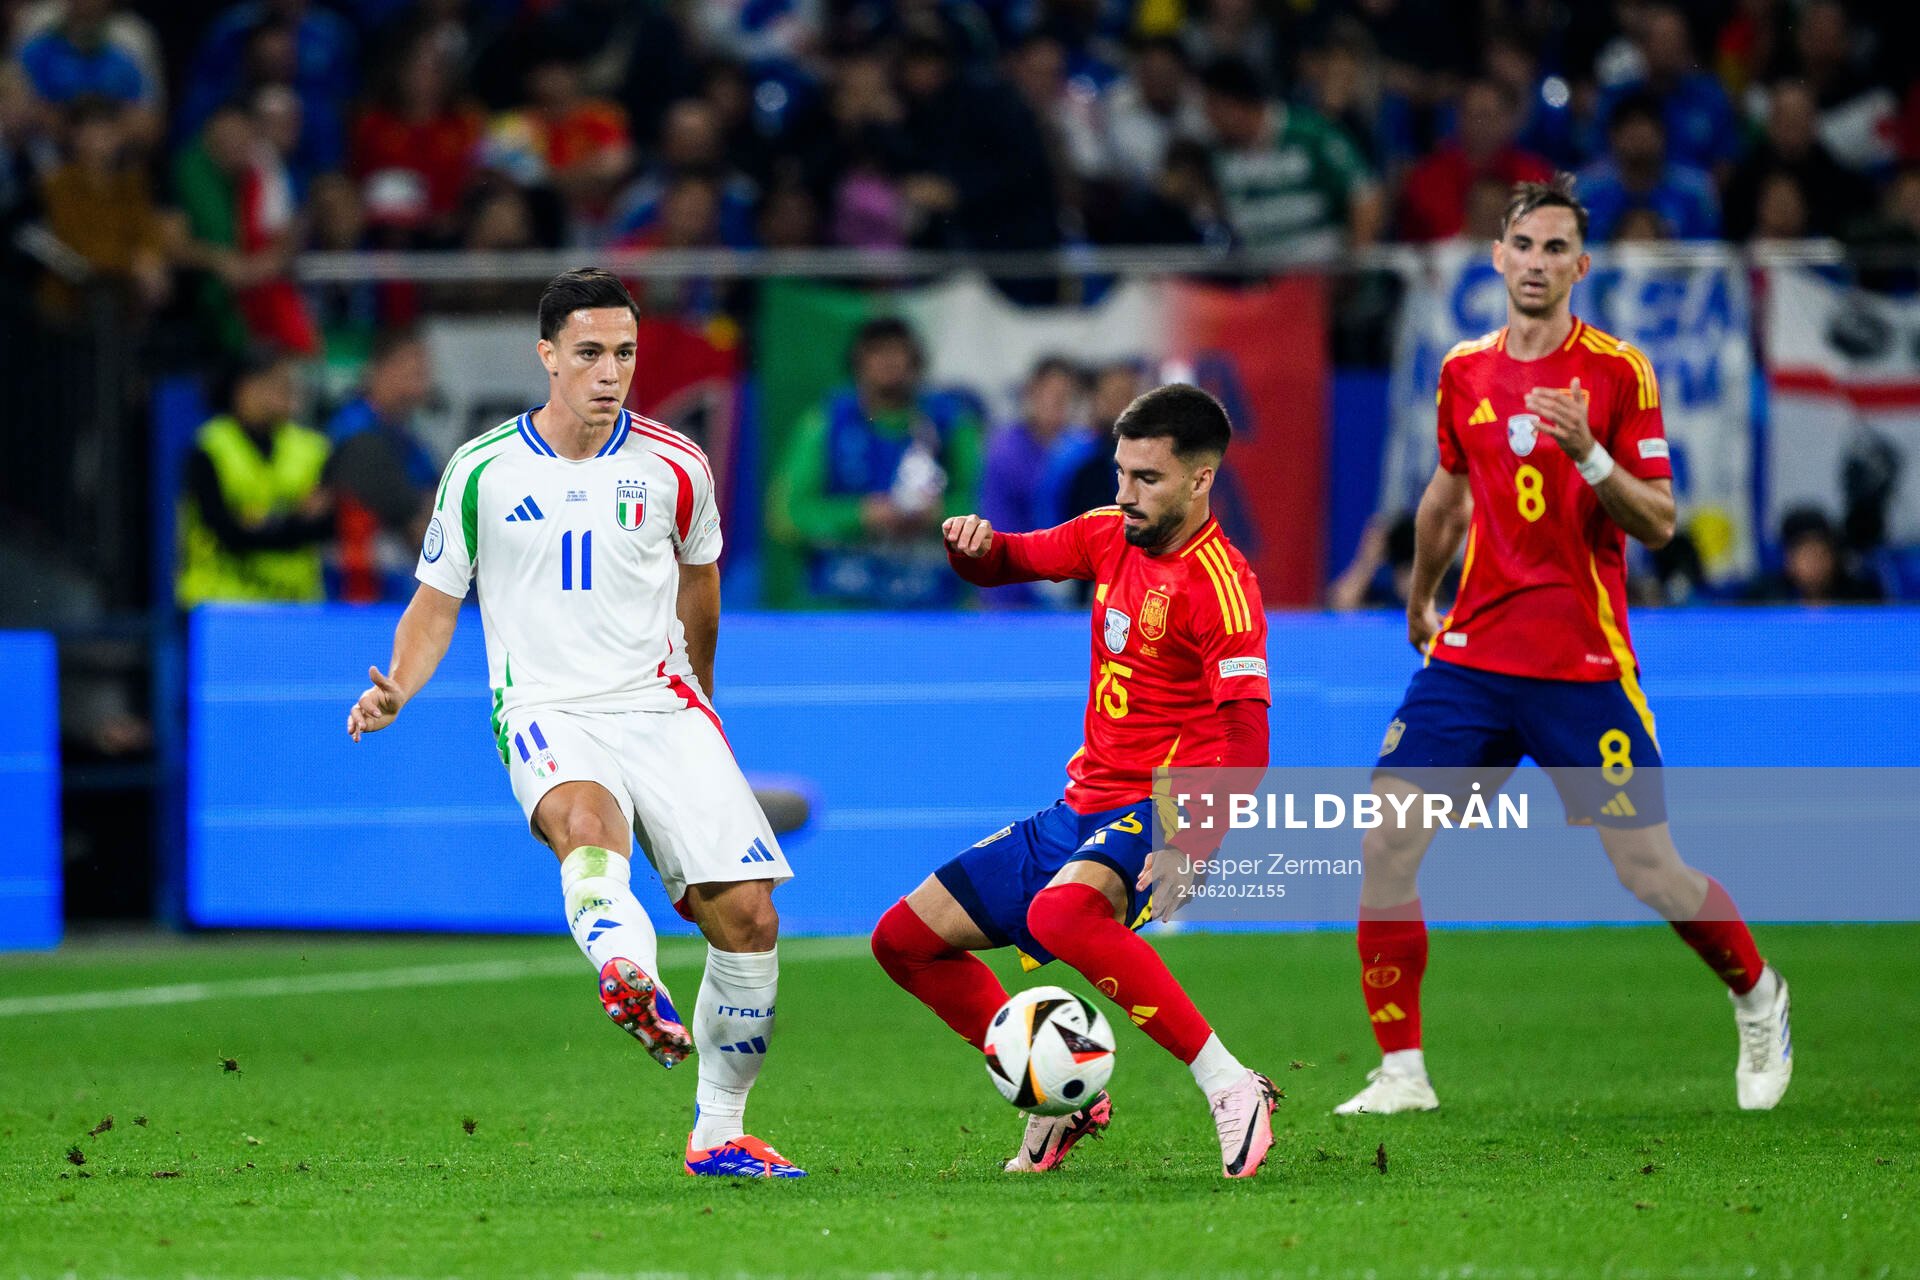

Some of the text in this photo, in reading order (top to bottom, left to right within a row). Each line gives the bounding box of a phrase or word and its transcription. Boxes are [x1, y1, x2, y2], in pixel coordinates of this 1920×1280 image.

[618, 489, 644, 499] ITALIA
[1514, 464, 1546, 522] 8
[561, 530, 592, 591] 11
[514, 720, 549, 764] 11
[1598, 728, 1634, 786] 8
